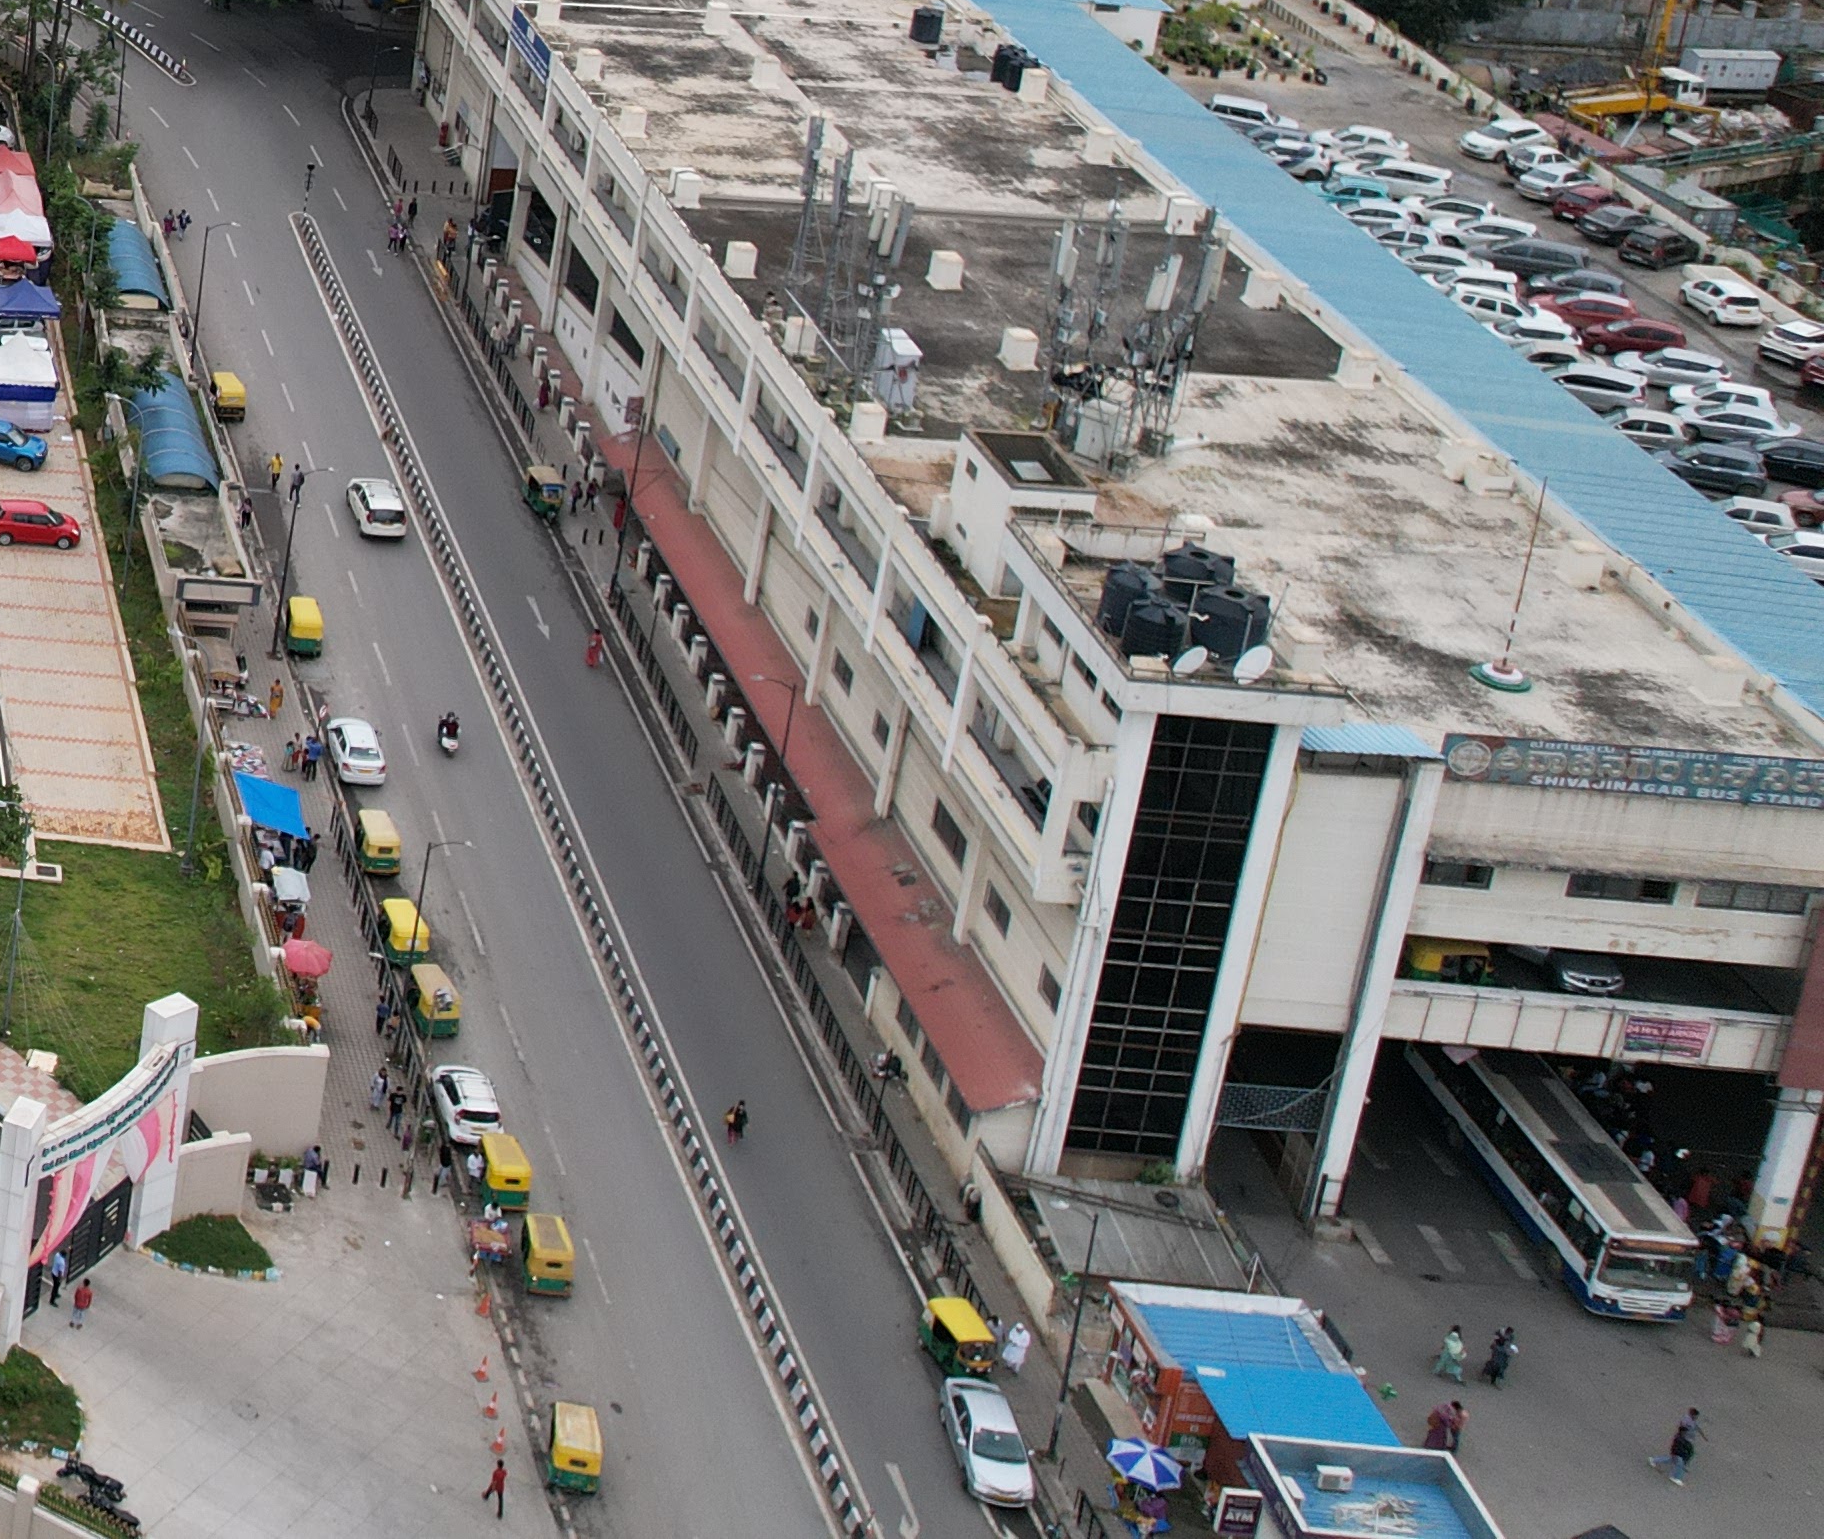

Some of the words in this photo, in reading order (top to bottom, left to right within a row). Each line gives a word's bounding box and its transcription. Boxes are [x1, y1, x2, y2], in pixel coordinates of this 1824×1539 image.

[1528, 774, 1687, 797] SHIVAJINAGAR
[1695, 787, 1741, 800] BUS
[1751, 791, 1823, 807] STAND
[1224, 1508, 1254, 1523] ATM
